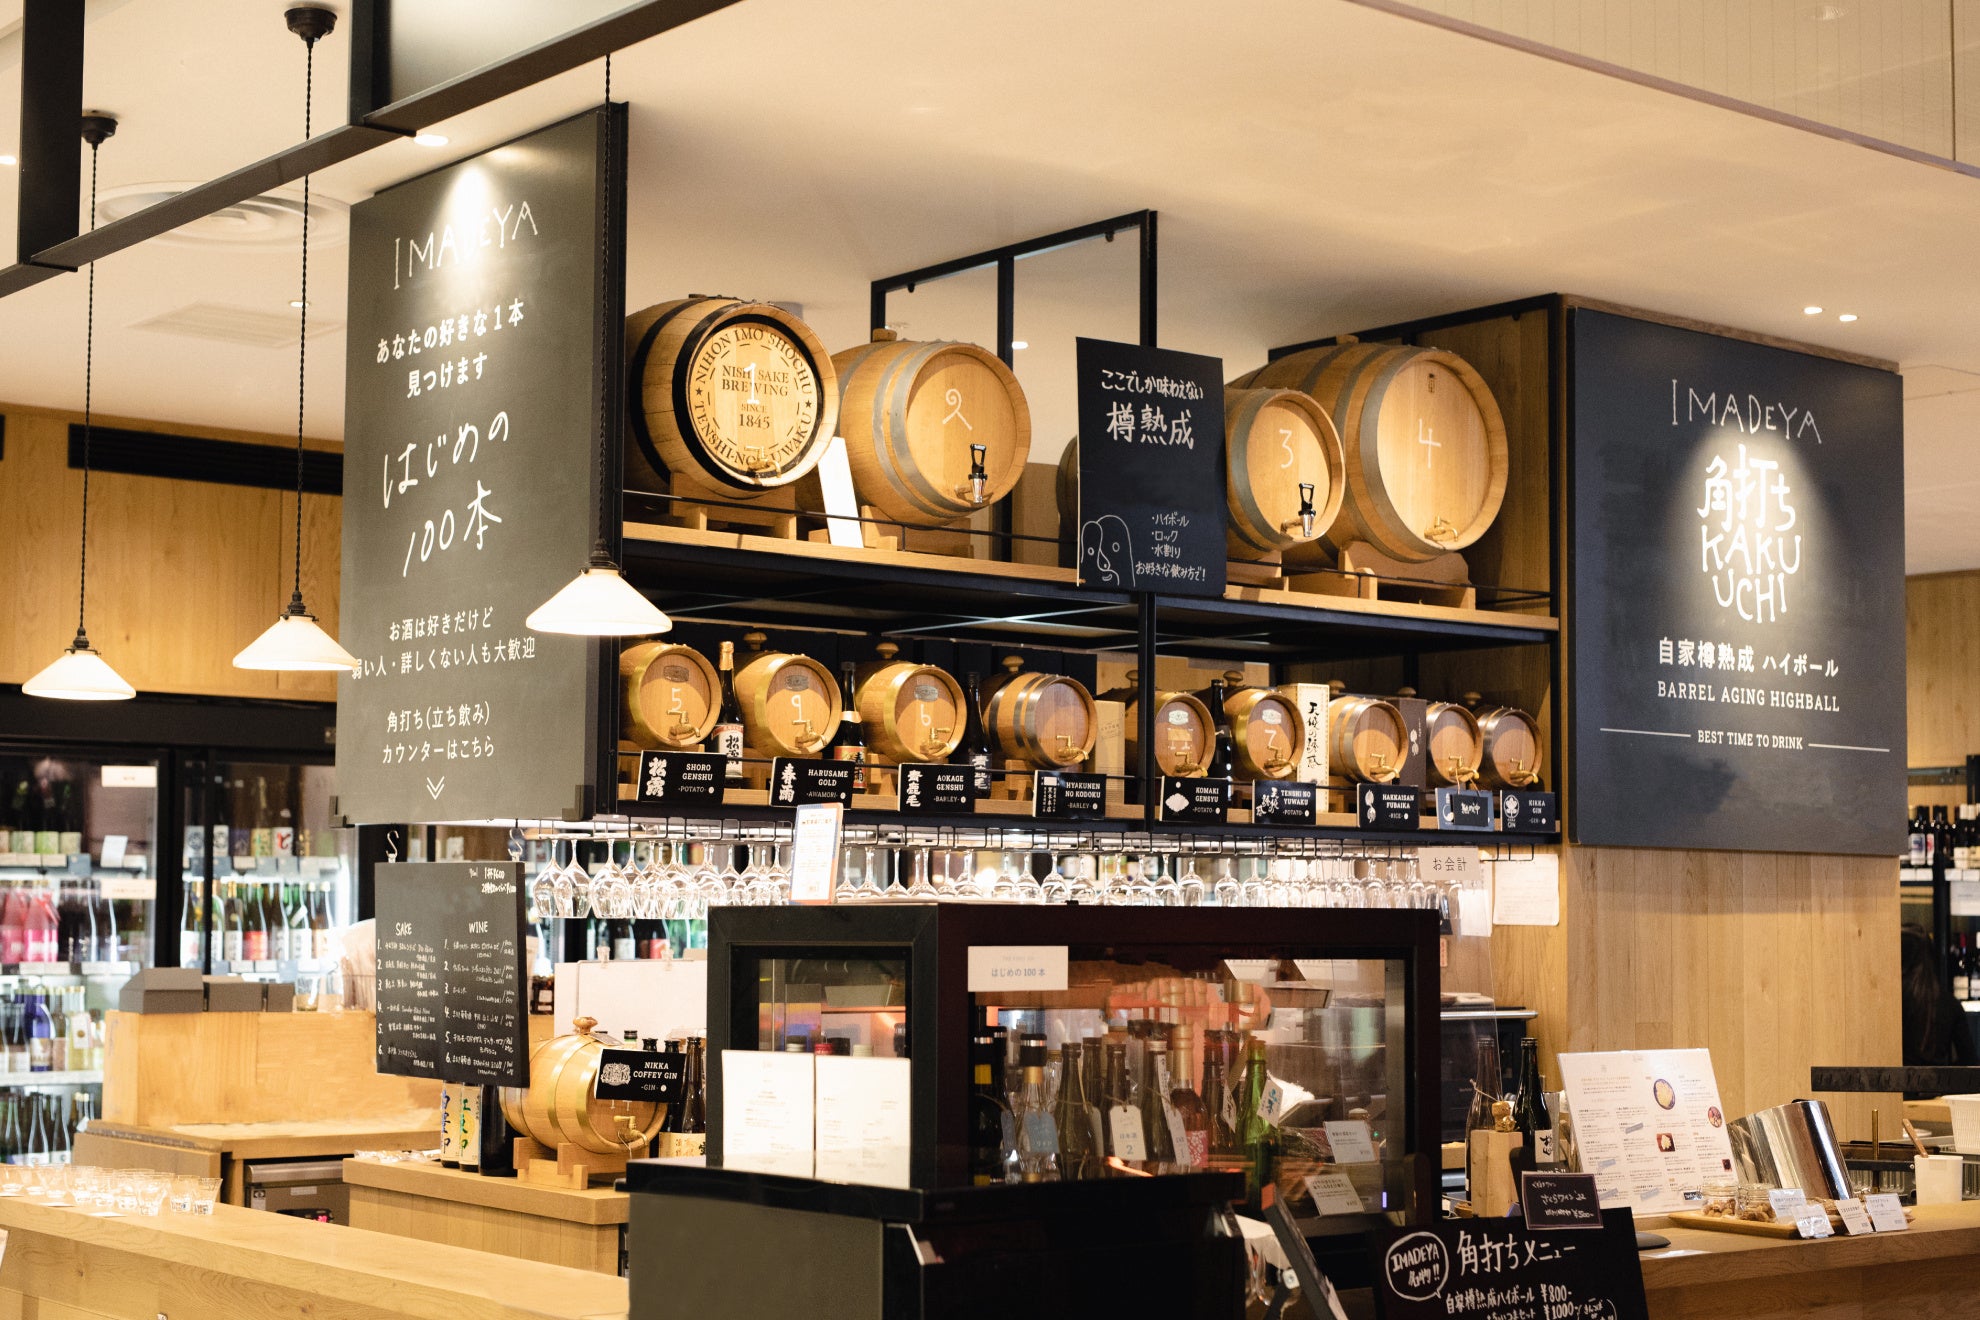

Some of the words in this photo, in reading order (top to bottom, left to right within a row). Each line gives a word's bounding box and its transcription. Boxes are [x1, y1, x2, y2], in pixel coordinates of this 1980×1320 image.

[394, 201, 538, 290] IMAEYA
[696, 333, 731, 384] NIHON
[734, 327, 764, 341] IMO
[768, 333, 812, 394] SHOCHU
[407, 352, 487, 398] 見つけます
[744, 362, 760, 405] 1
[758, 369, 789, 384] SAKE
[1102, 369, 1204, 400] ここでしか味わえない
[741, 403, 767, 412] SINCE
[1672, 379, 1821, 444] IMADEYA
[739, 414, 770, 429] 1845
[1106, 401, 1194, 450] 樽熟成
[1278, 429, 1294, 468] 3
[1418, 418, 1442, 469] 4
[383, 411, 509, 508] はじめの
[1697, 444, 1796, 532] 角打ち
[403, 480, 502, 577] 100本
[1701, 525, 1801, 574] KAKU
[1712, 569, 1787, 624] UCHI
[389, 606, 493, 641] お酒は好きだけど
[1659, 636, 1755, 673] 自家樽熟成
[1762, 652, 1839, 677] ハイボール
[672, 688, 682, 711] 5
[1657, 680, 1715, 701] BARREL
[1721, 686, 1765, 706] AGING
[1770, 690, 1839, 712] HIGHBALL
[387, 701, 490, 733] 角打ち(立ち飲み)
[921, 704, 931, 727] 6
[382, 735, 494, 764] カウンターはこちら
[1264, 730, 1277, 748] 7
[1698, 730, 1723, 744] BEST
[1727, 732, 1753, 747] TIME
[1756, 734, 1769, 747] TO
[1772, 735, 1803, 750] DRINK
[682, 772, 713, 781] GENSHU
[686, 763, 712, 772] SHORO
[808, 768, 849, 778] HARUSAME
[818, 778, 837, 786] GOLD
[936, 783, 964, 791] GENSHU
[937, 774, 964, 783] AOKAGE
[1066, 781, 1101, 790] HYAKUNEN
[1195, 787, 1219, 795] KOMAKI
[1195, 795, 1219, 803] GENSYU
[1281, 789, 1300, 798] TENSHI
[1302, 790, 1311, 798] NO
[1382, 794, 1415, 802] HAKKAISAN
[1283, 798, 1309, 806] YUWAKU
[1433, 857, 1467, 871] お会計
[395, 921, 413, 936] SAKE
[469, 921, 489, 934] WINE
[633, 1070, 662, 1079] COFFEY
[664, 1072, 678, 1080] GIN
[644, 1062, 669, 1070] NIKKA
[1126, 1145, 1134, 1155] 2
[1390, 1243, 1440, 1272] IMADEYA
[1457, 1230, 1576, 1276] 角打ちメニュー
